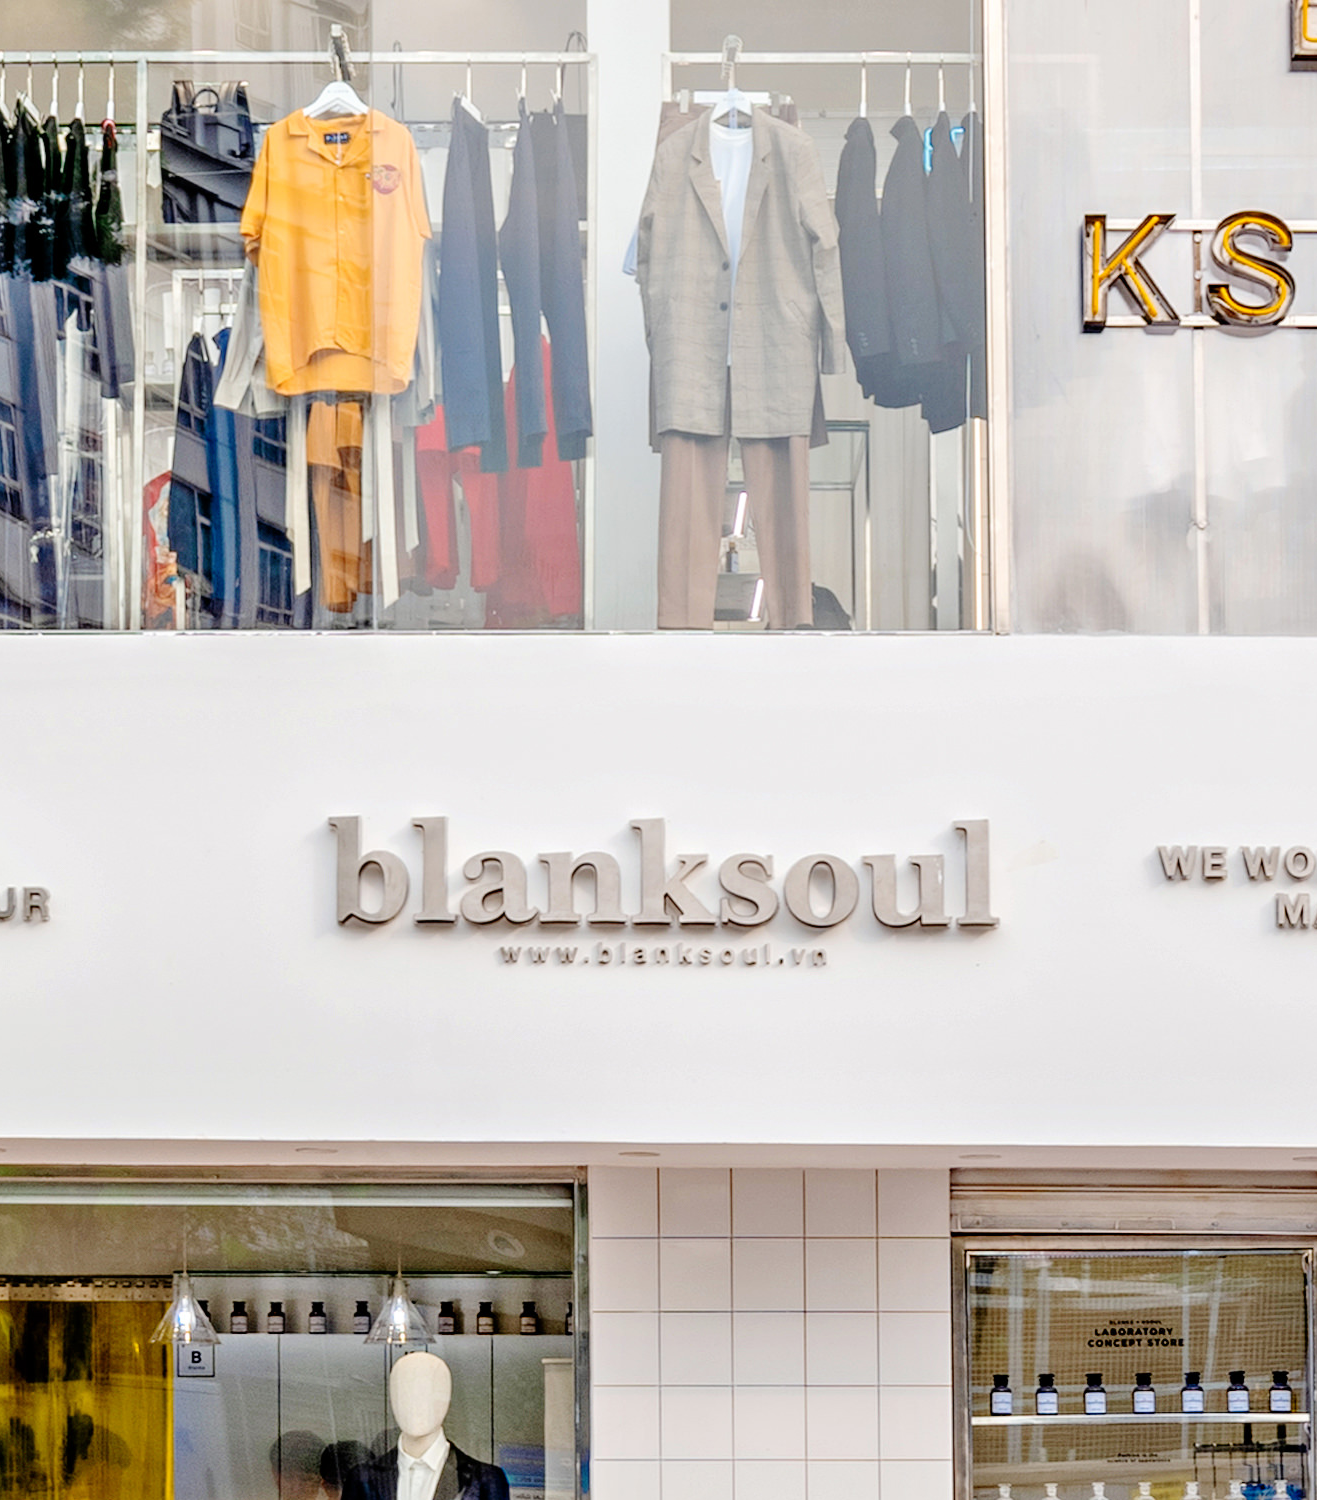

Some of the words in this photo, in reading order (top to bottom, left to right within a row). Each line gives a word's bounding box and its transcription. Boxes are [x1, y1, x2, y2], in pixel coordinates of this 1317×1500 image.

[327, 815, 1000, 929] blanksoul
[1157, 845, 1229, 881] WE
[498, 941, 830, 969] www.blanksoul.vn
[1094, 1327, 1173, 1337] LABORATORY
[1087, 1338, 1143, 1348] CONCEPT
[1147, 1338, 1185, 1348] STORE
[191, 1350, 202, 1364] B
